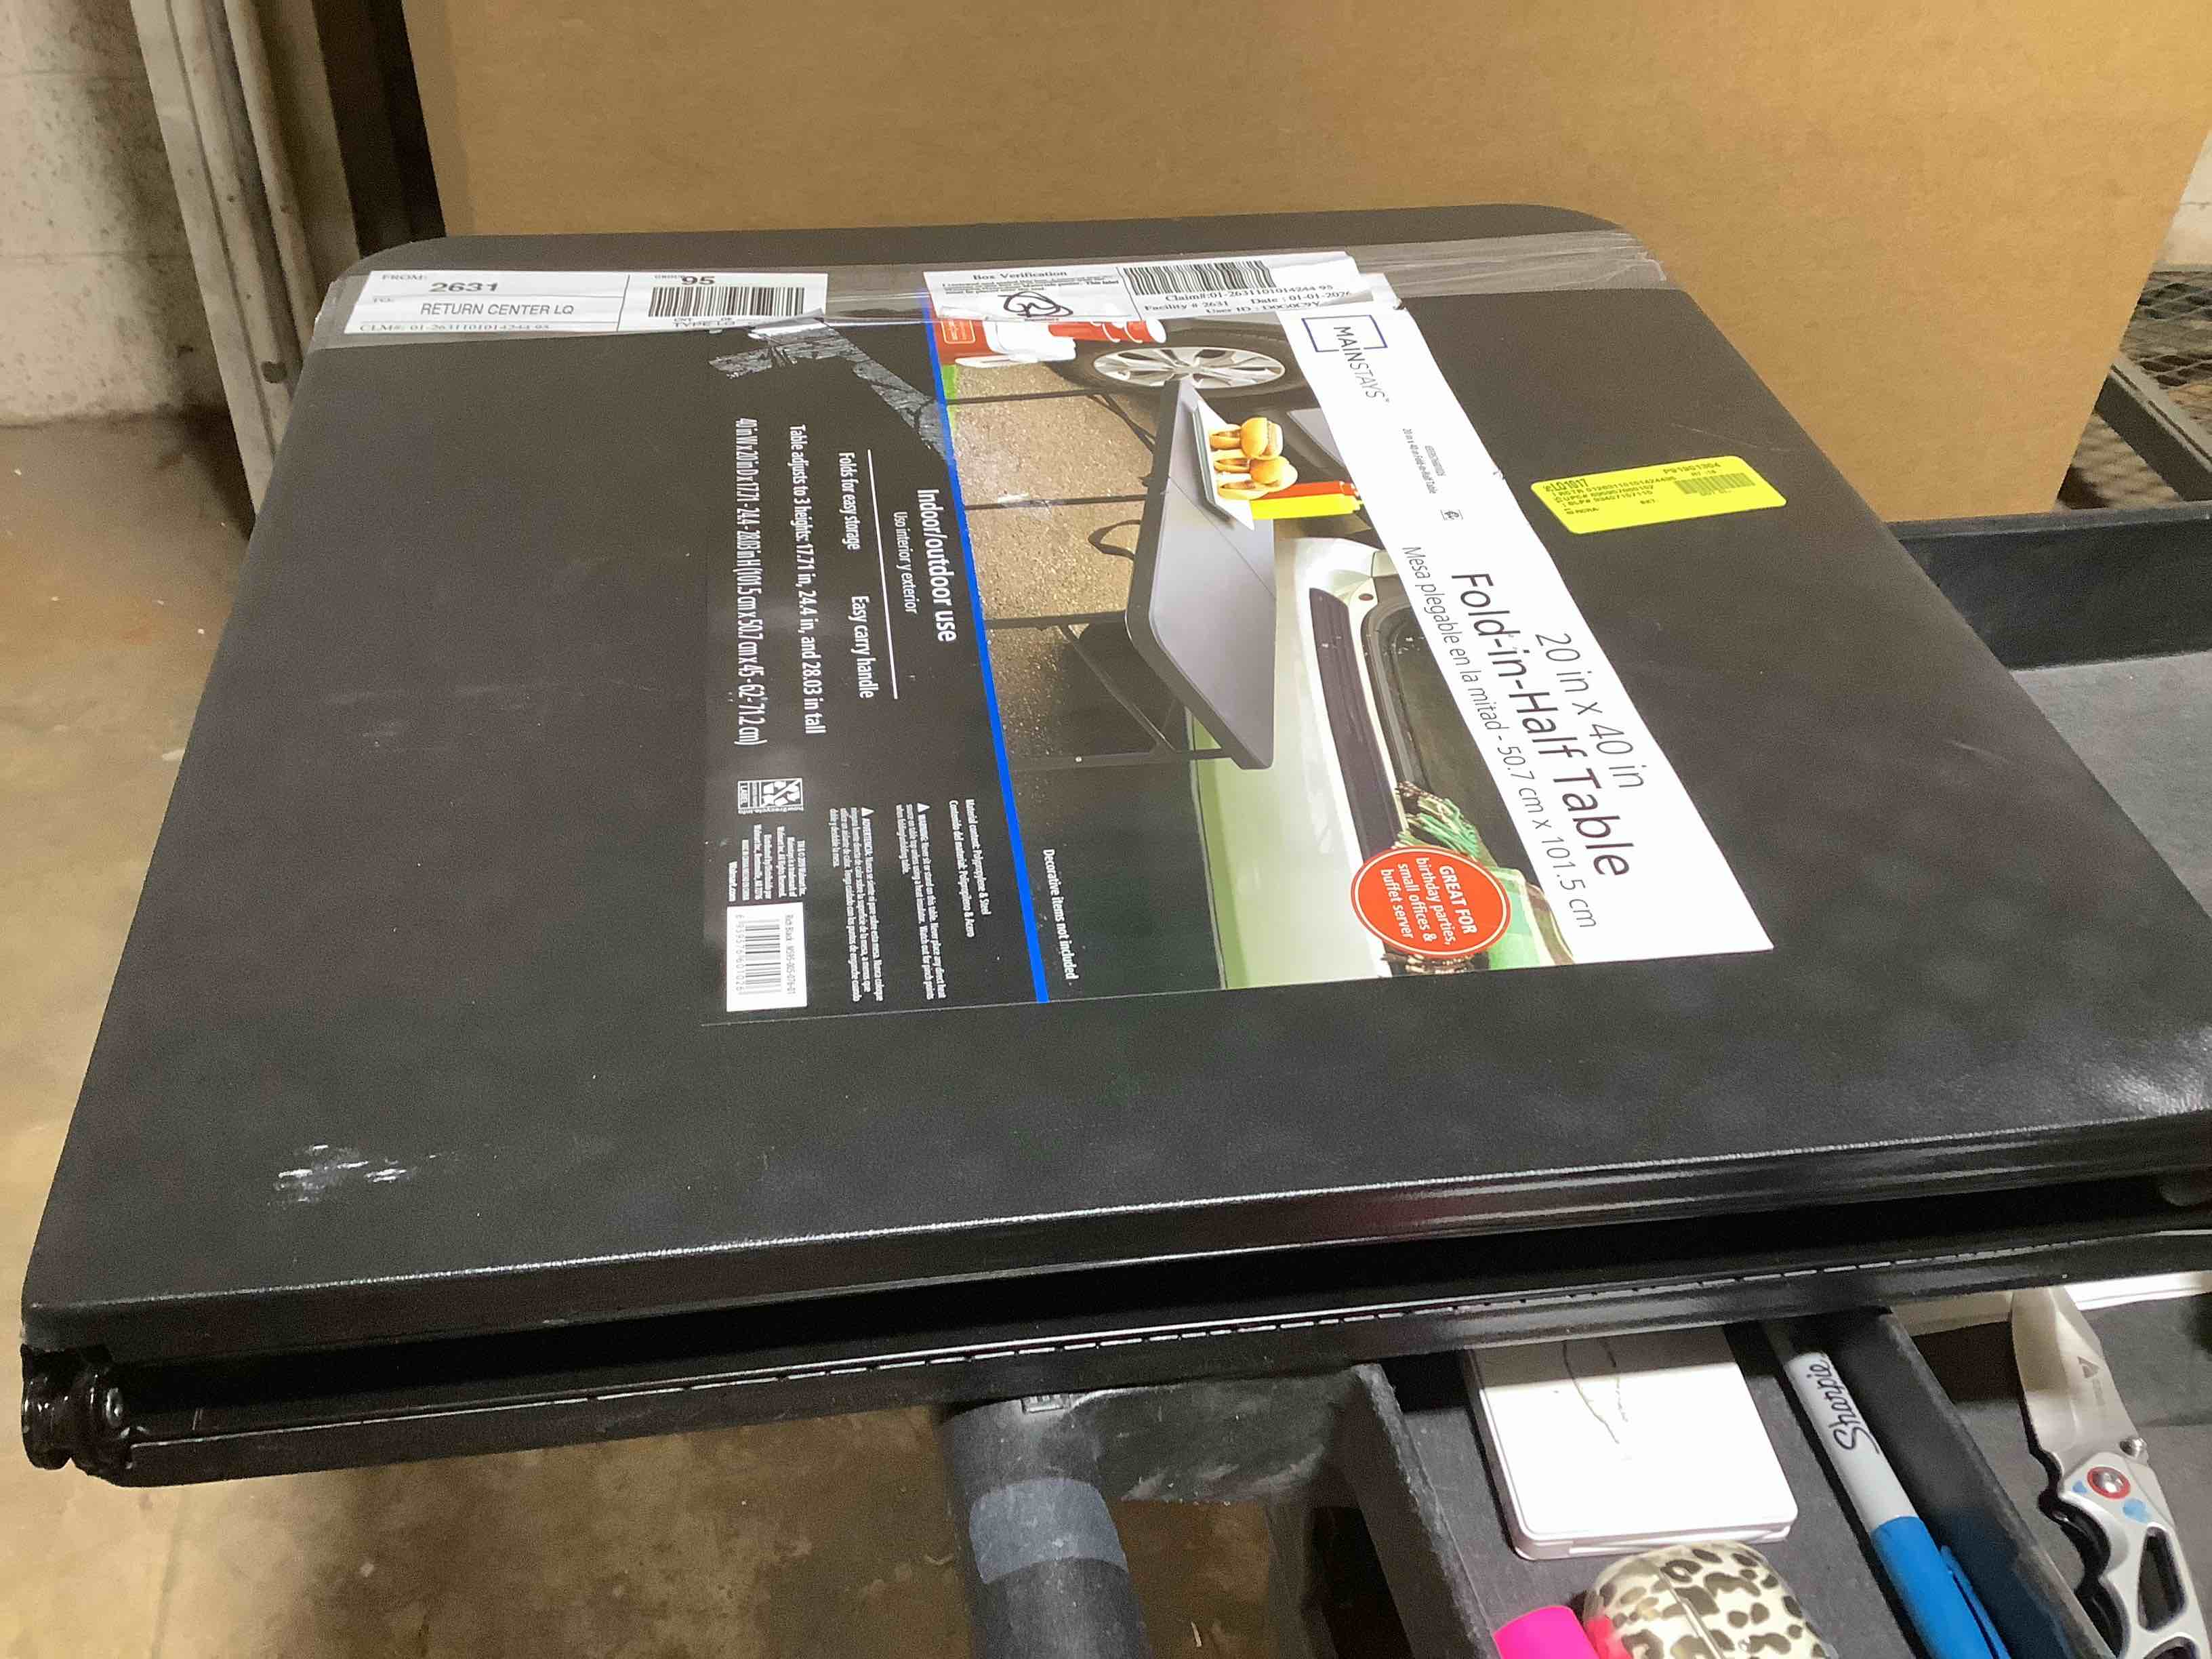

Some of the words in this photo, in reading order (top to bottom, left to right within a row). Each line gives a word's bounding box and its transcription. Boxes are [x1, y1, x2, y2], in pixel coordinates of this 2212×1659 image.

[428, 282, 499, 292] 2631
[682, 275, 715, 285] 95
[420, 303, 483, 314] RETURN
[487, 304, 550, 315] CENTER
[554, 305, 574, 314] LQ
[1145, 303, 1187, 311] Facility
[790, 424, 808, 449] Table
[736, 451, 758, 461] 20
[787, 450, 809, 484] adjusts
[838, 452, 857, 478] Folds
[737, 482, 760, 502] 17.71
[794, 486, 808, 497] to
[841, 478, 859, 493] for
[839, 494, 857, 514] easy
[790, 506, 813, 542] heights:
[842, 514, 861, 550] storage
[893, 511, 908, 528] Uso
[796, 544, 815, 570] 17.71
[895, 528, 914, 562] interior
[917, 489, 955, 606] Indoor/outdoor
[1402, 547, 1431, 579] Mesa
[796, 573, 816, 587] in,
[901, 571, 920, 614] exterior
[737, 596, 756, 611] cm
[798, 590, 817, 615] 24.4
[848, 596, 869, 622] Easy
[1414, 583, 1462, 644] plegable
[738, 619, 763, 640] 50.7
[798, 618, 819, 633] in,
[935, 611, 957, 642] use
[738, 641, 757, 655] cm
[801, 636, 821, 659] and
[851, 625, 870, 655] carry
[1534, 633, 1580, 662] 20
[1449, 648, 1470, 665] en
[802, 661, 823, 695] 28.03
[857, 657, 879, 699] handle
[1460, 670, 1481, 682] la
[1557, 670, 1593, 692] in
[804, 698, 824, 710] in
[1467, 687, 1510, 730] mitad
[1572, 701, 1603, 715] x
[734, 726, 767, 745] cm)
[804, 712, 826, 734] tall
[1452, 573, 1588, 758] Fold-in-Half
[1553, 768, 1635, 876] Table
[1589, 724, 1633, 754] 40
[1497, 746, 1534, 780] 50.7
[1609, 764, 1647, 788] in
[1518, 787, 1544, 813] cm
[1532, 819, 1552, 829] x
[1043, 848, 1061, 896] Decorative
[1542, 836, 1586, 890] 101.5
[979, 899, 992, 915] Steel
[1051, 897, 1065, 922] items
[1380, 869, 1404, 903] buffet
[1393, 904, 1414, 939] server
[1398, 863, 1420, 892] small
[1409, 894, 1431, 930] offices
[1423, 933, 1437, 942] &
[1416, 857, 1441, 902] birthday
[1429, 904, 1456, 945] parties,
[1439, 865, 1469, 906] GREAT
[1455, 907, 1477, 934] FOR
[1569, 899, 1597, 928] cm
[965, 918, 975, 937] Acero
[1056, 923, 1069, 940] not
[1059, 940, 1080, 979] included
[1807, 1358, 1880, 1454] Sharpie
